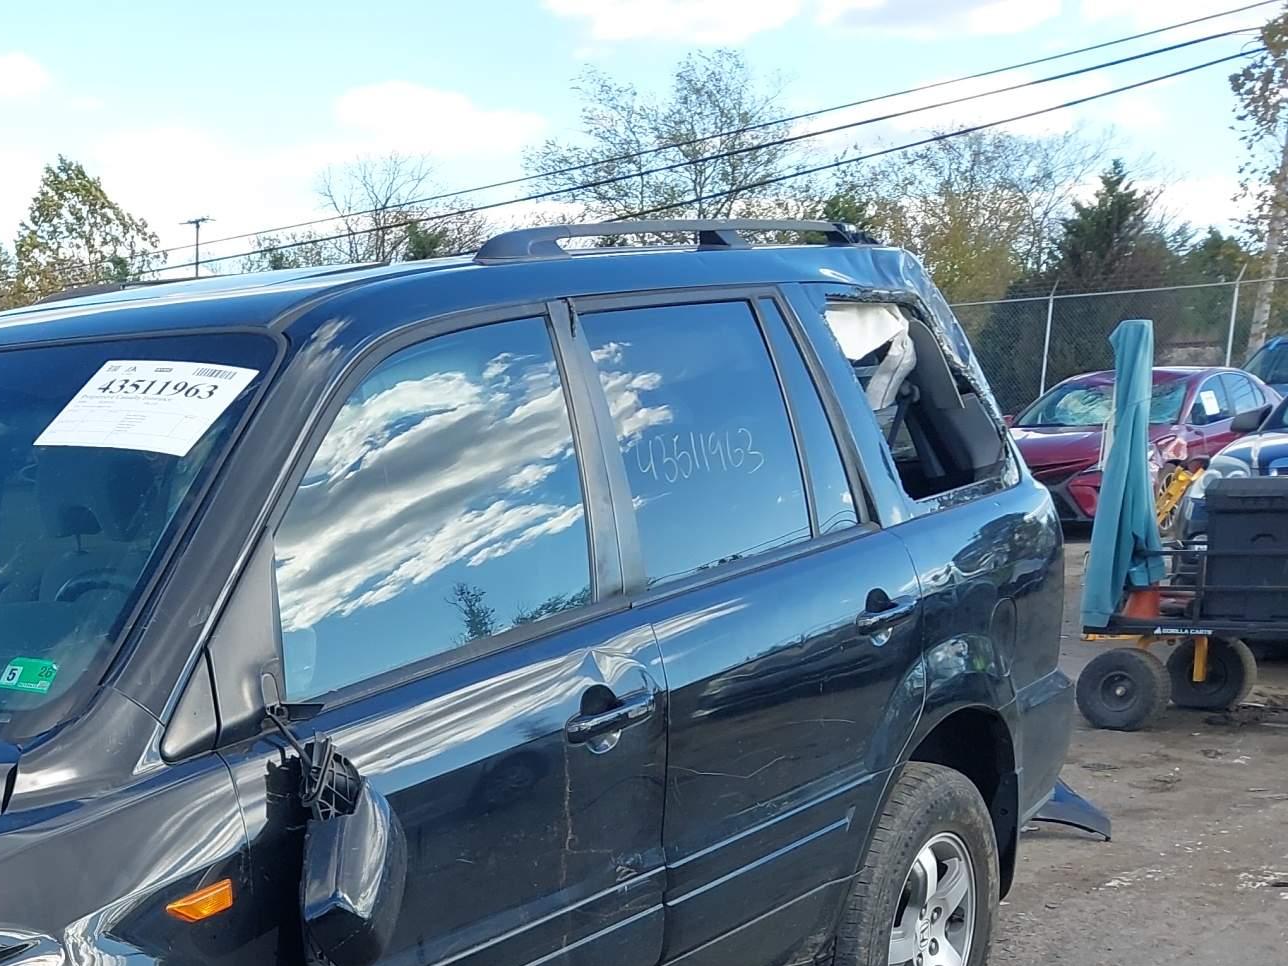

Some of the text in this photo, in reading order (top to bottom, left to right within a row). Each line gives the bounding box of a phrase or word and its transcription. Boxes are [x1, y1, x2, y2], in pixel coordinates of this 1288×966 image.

[96, 378, 219, 400] 43511963
[635, 427, 765, 484] 43511963
[6, 666, 53, 682] 5 26
